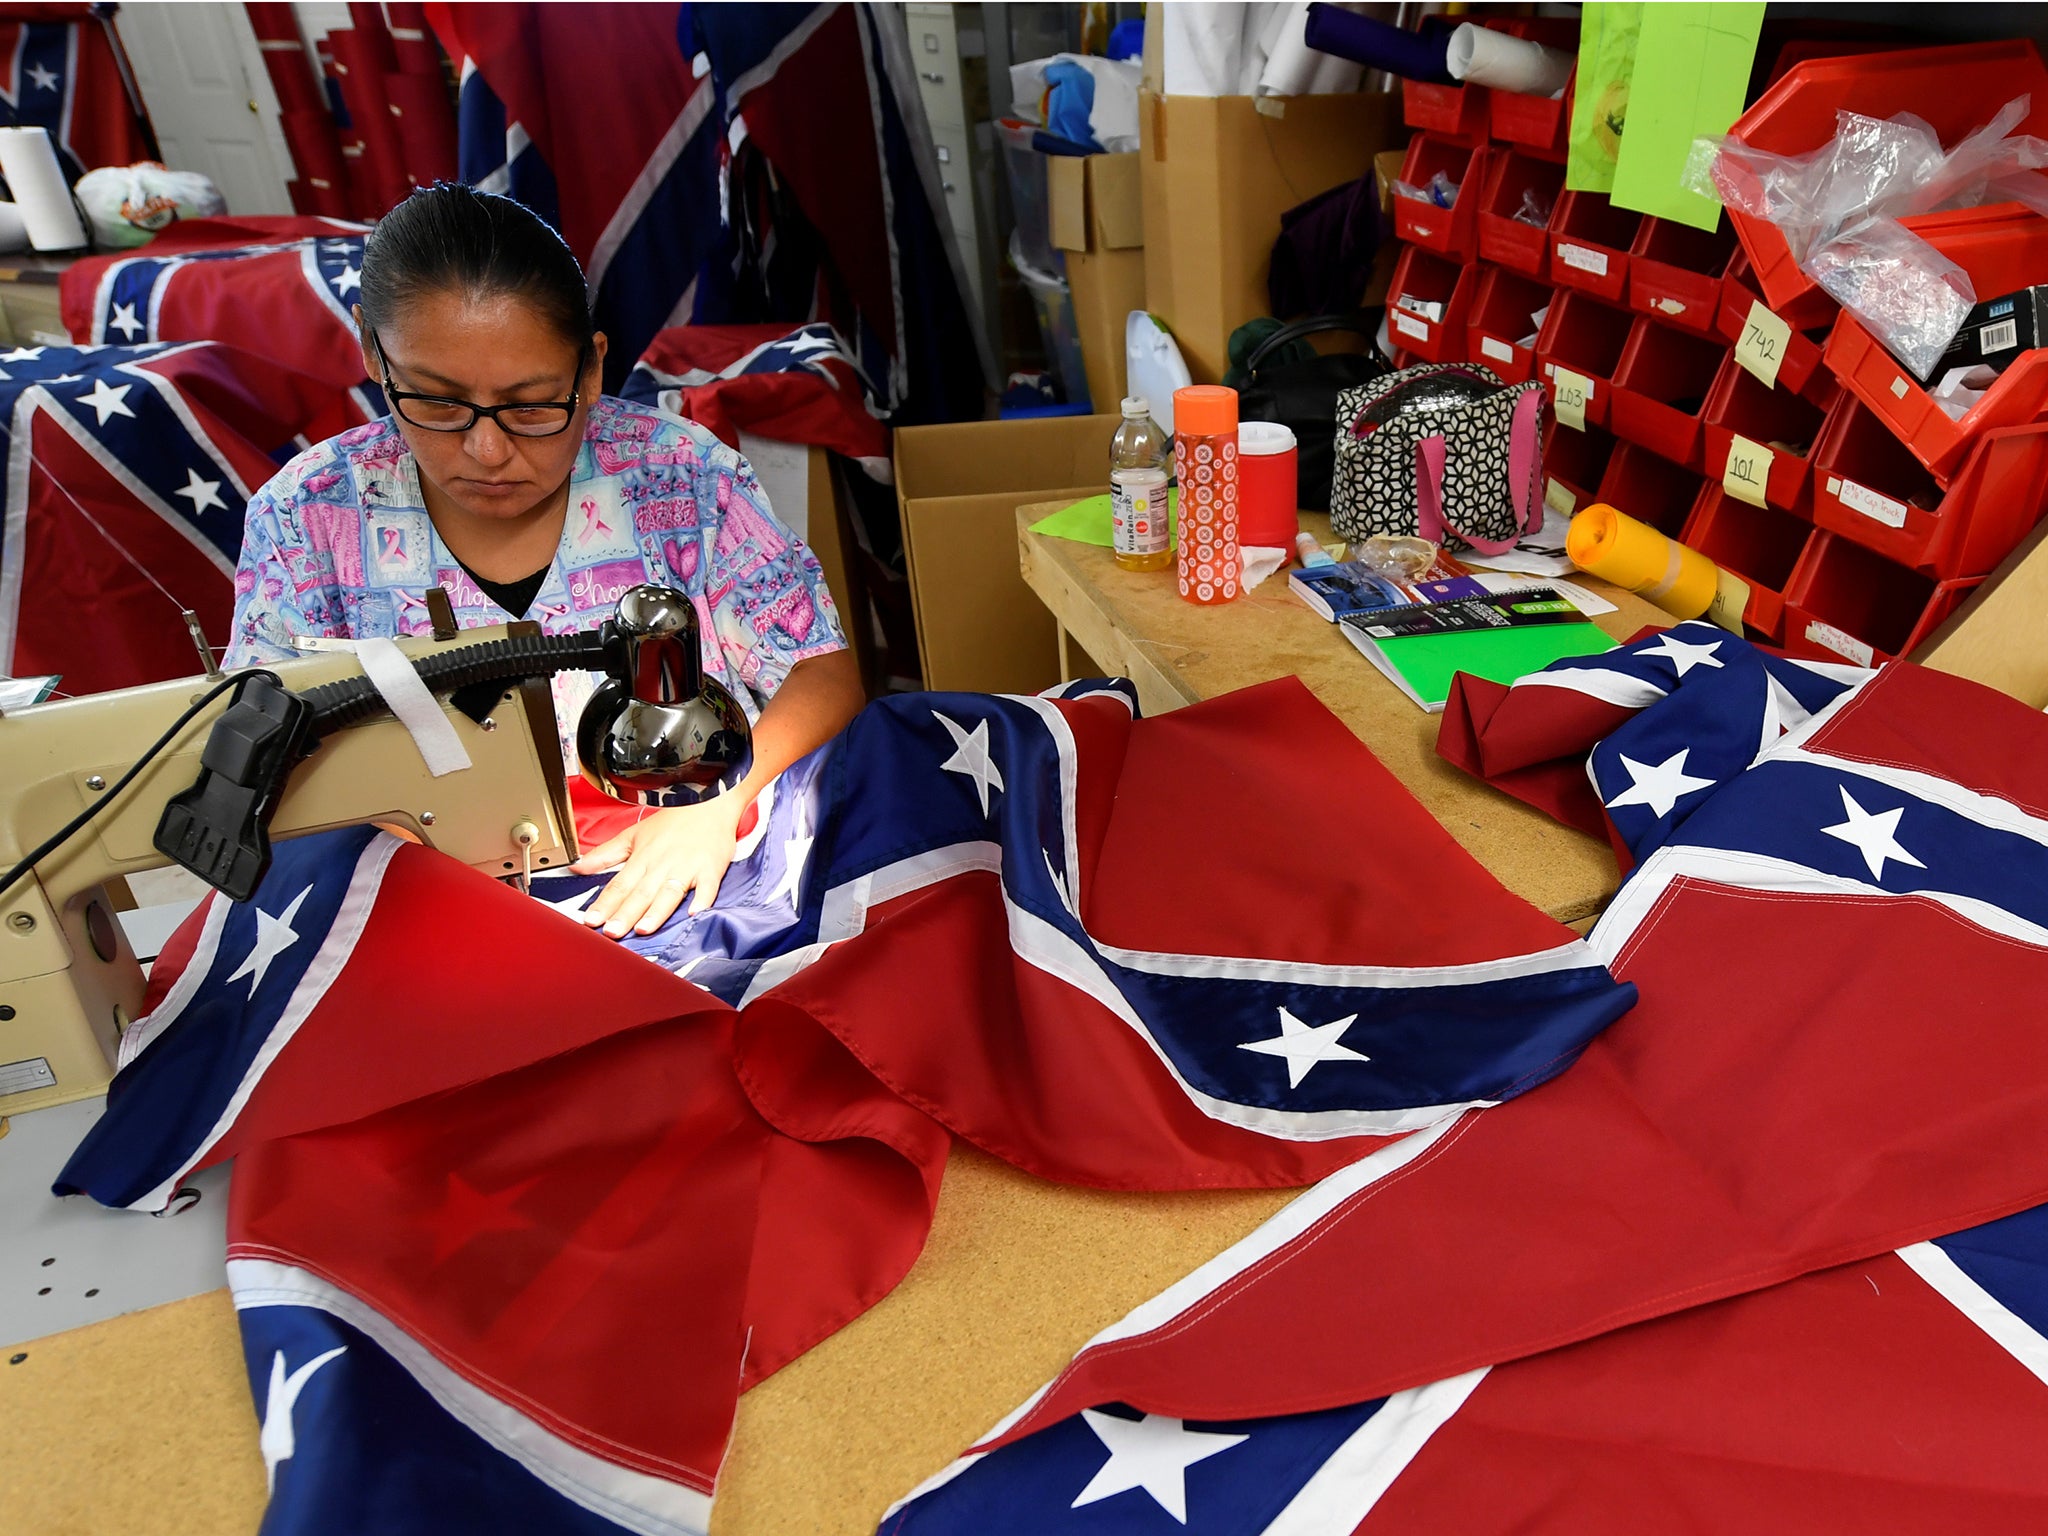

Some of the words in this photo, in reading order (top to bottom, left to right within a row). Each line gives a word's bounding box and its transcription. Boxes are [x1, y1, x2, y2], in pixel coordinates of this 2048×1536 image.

[1745, 323, 1775, 361] 742
[1556, 386, 1583, 408] 103
[1729, 455, 1759, 486] 101
[439, 568, 494, 613] hop
[572, 567, 634, 606] hop
[1713, 590, 1726, 612] 41
